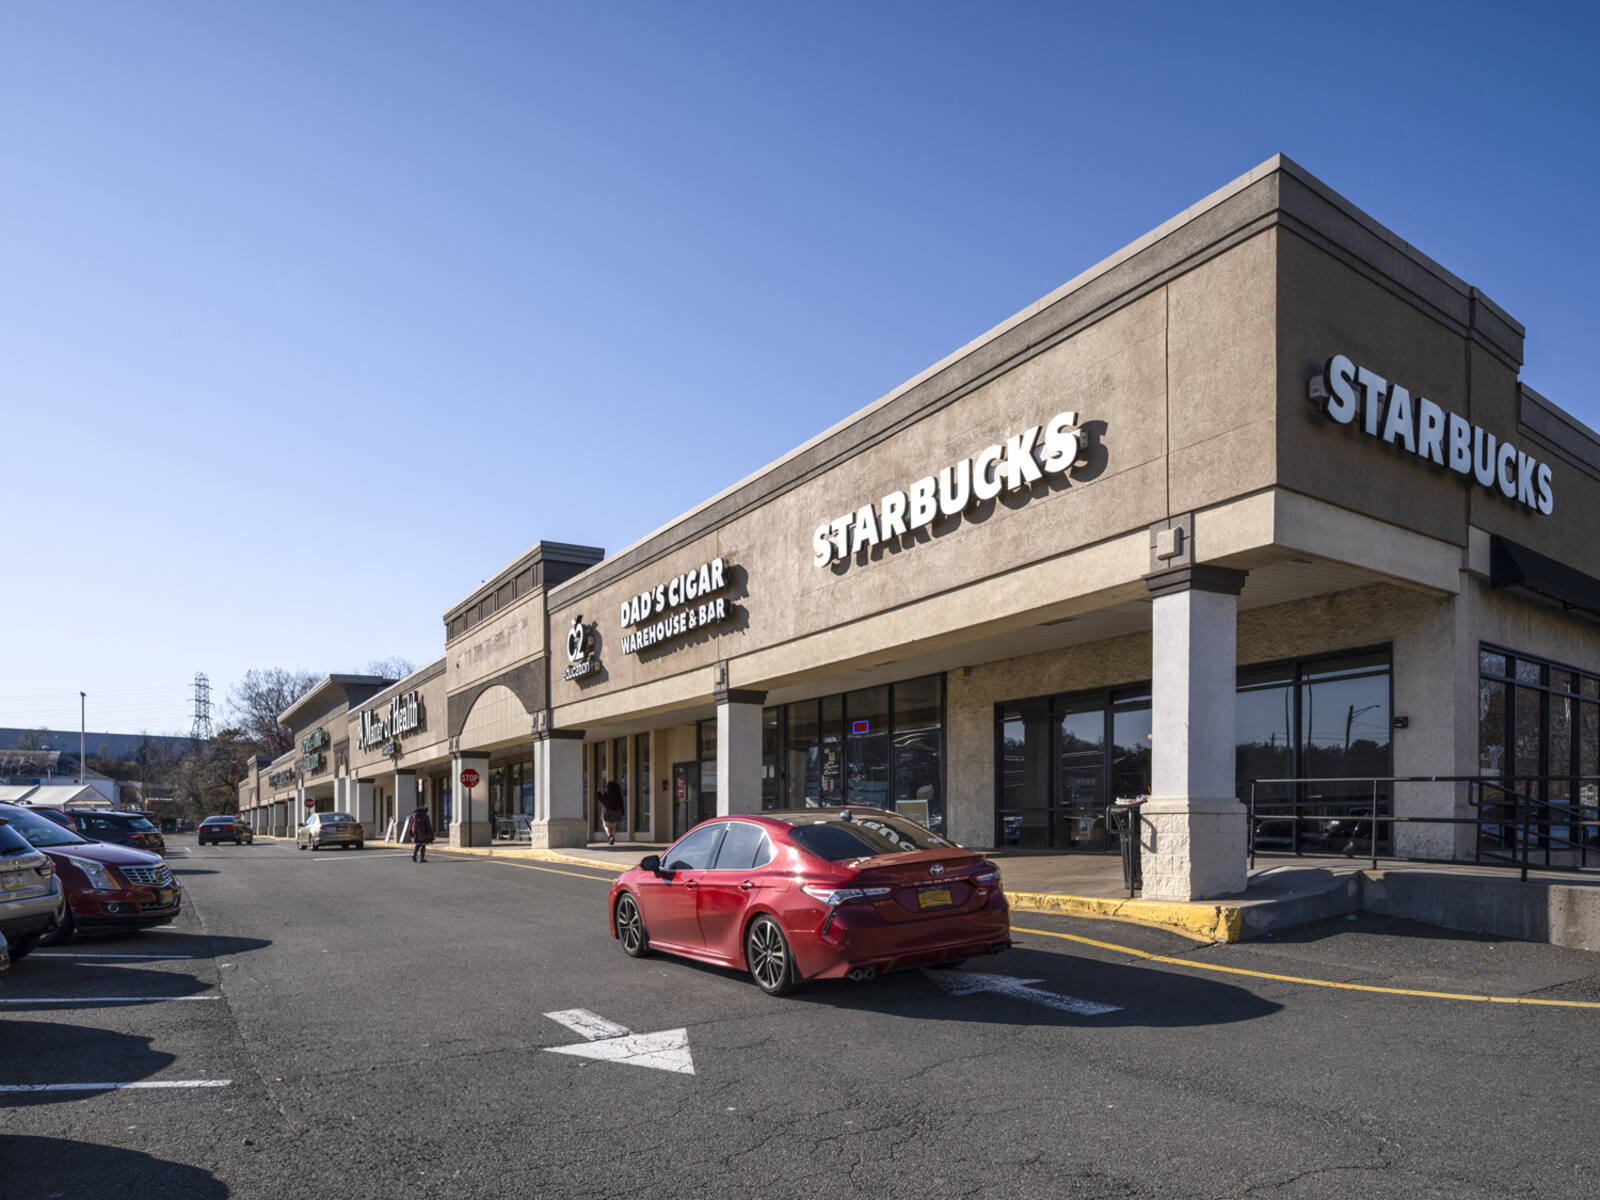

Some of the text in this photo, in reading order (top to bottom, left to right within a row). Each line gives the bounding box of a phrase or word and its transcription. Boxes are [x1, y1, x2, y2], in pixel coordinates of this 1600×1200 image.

[1328, 354, 1554, 516] STARBUCKS
[813, 411, 1078, 568] STARBUCKS
[620, 557, 725, 628] DAD'S CIGAR
[620, 598, 726, 655] WAREHOUSE & BAR
[392, 691, 419, 736] Health
[461, 773, 479, 783] STOP
